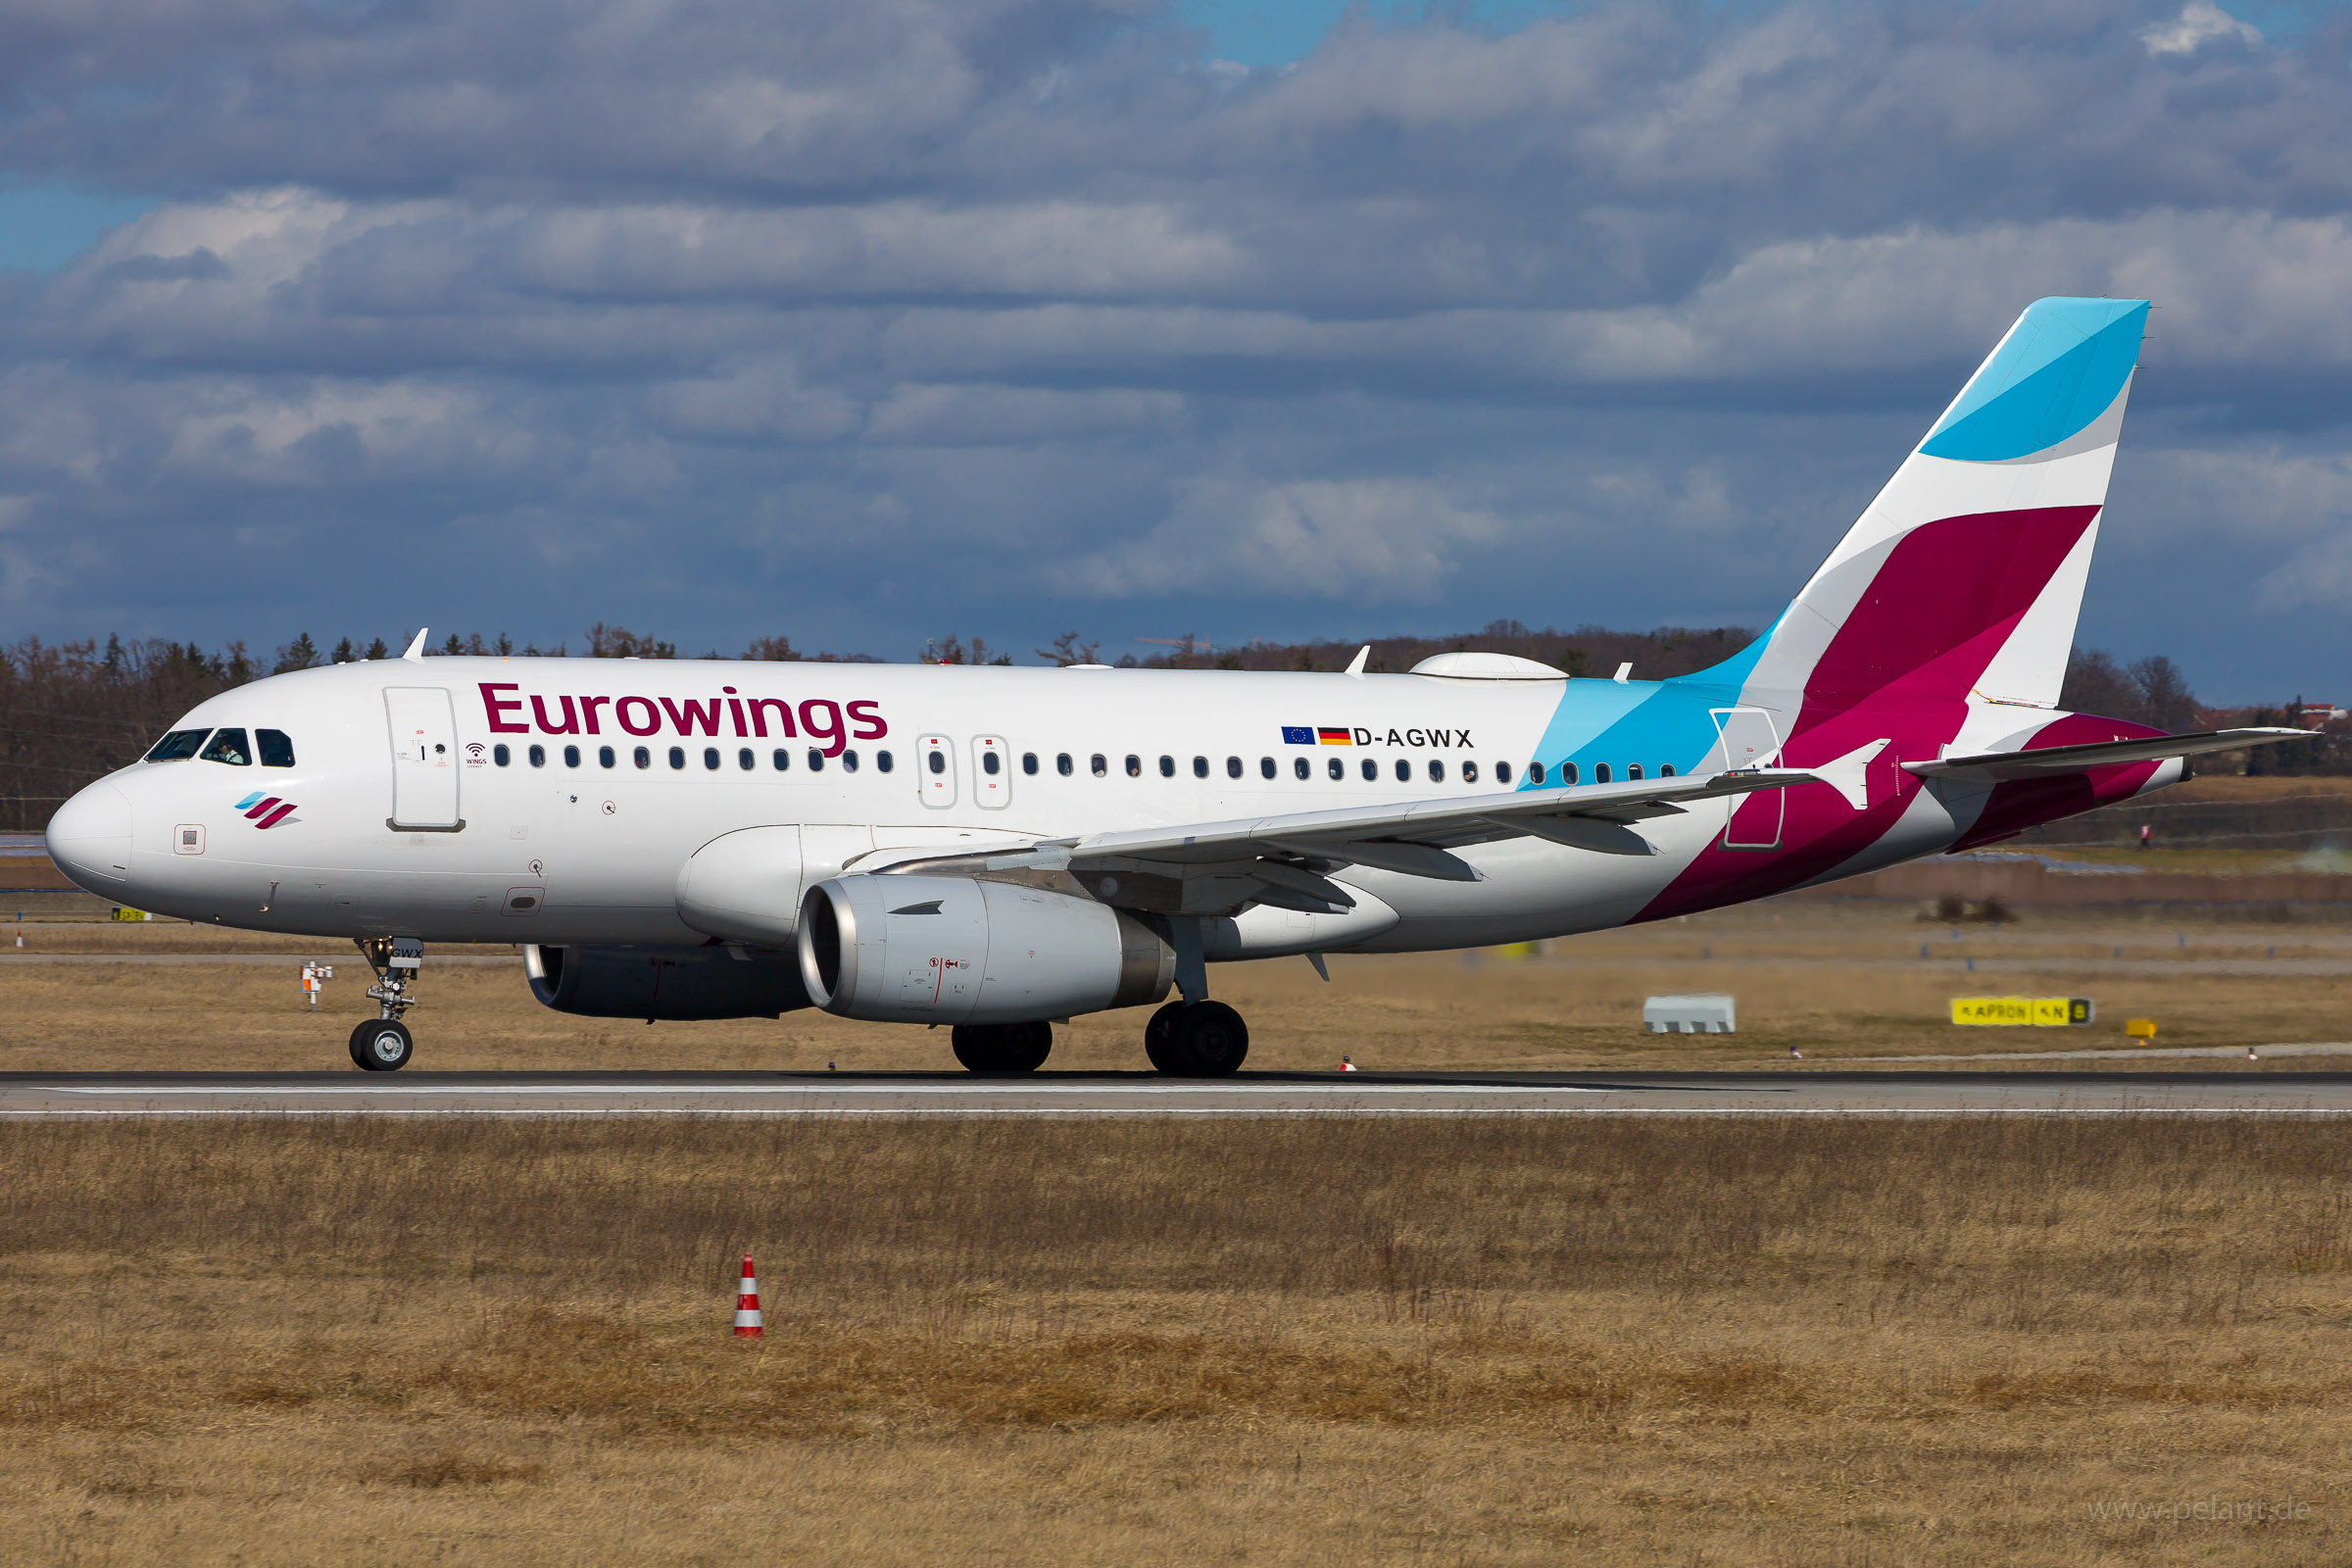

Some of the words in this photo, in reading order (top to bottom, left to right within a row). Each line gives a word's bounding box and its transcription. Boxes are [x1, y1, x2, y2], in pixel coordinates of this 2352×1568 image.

[478, 683, 889, 759] Eurowings
[1353, 727, 1475, 749] D-AGWX
[392, 948, 422, 958] GWX
[1975, 1004, 2027, 1019] APRON
[2053, 1005, 2064, 1019] N
